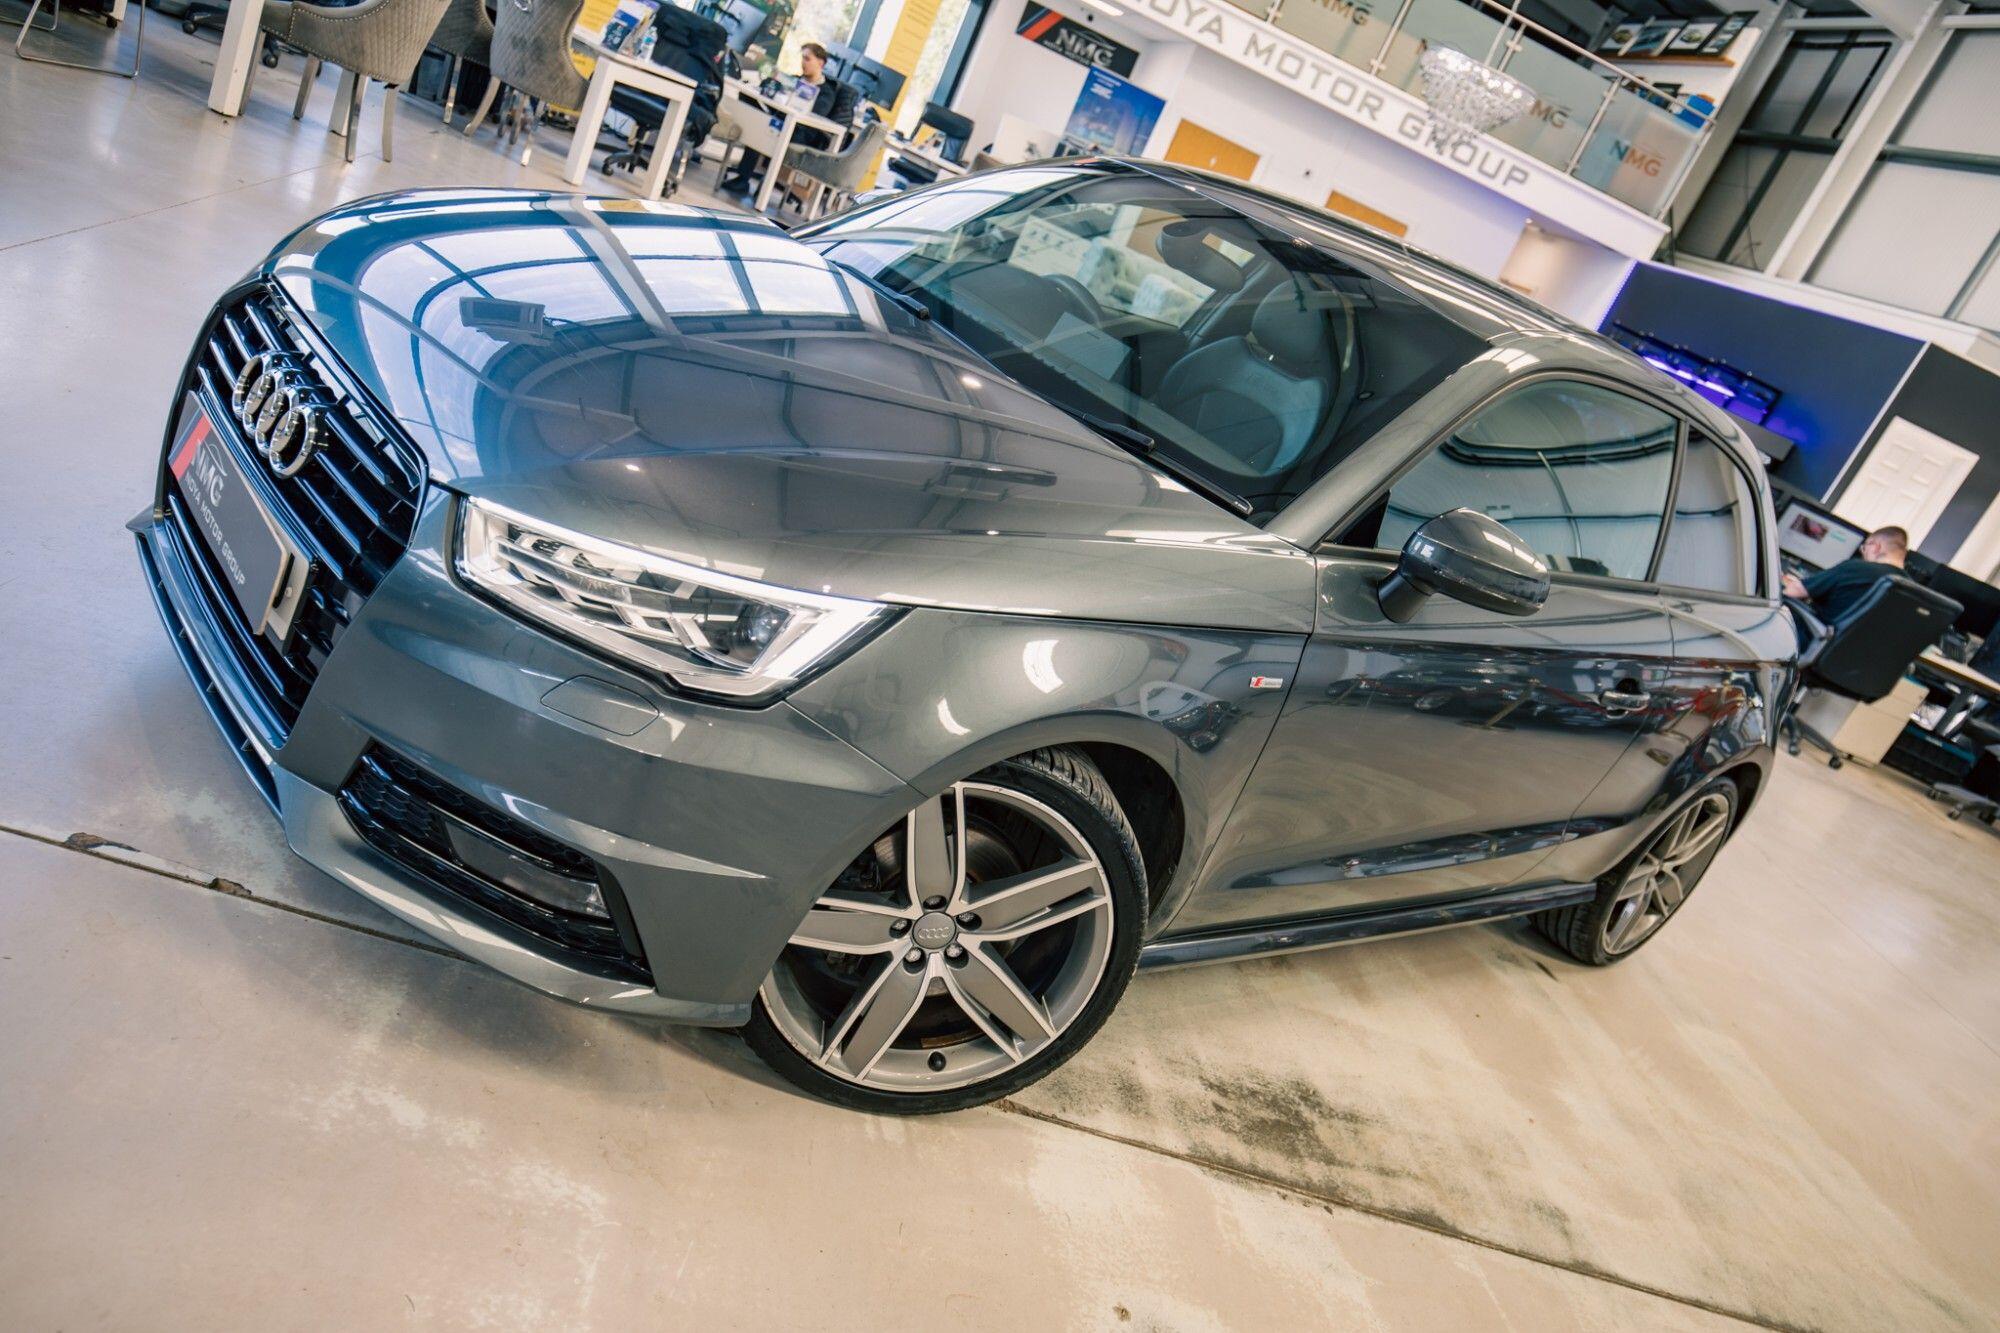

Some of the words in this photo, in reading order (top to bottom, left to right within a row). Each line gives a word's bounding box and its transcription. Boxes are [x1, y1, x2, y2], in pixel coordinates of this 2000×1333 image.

[1055, 27, 1114, 67] NMG
[1134, 0, 1223, 43] OYA
[1243, 33, 1385, 121] MOTOR
[1528, 99, 1569, 129] MG
[1609, 140, 1662, 178] NMG
[191, 438, 225, 508] NMG
[200, 501, 223, 546] MOTOR
[221, 541, 246, 586] GROUP
